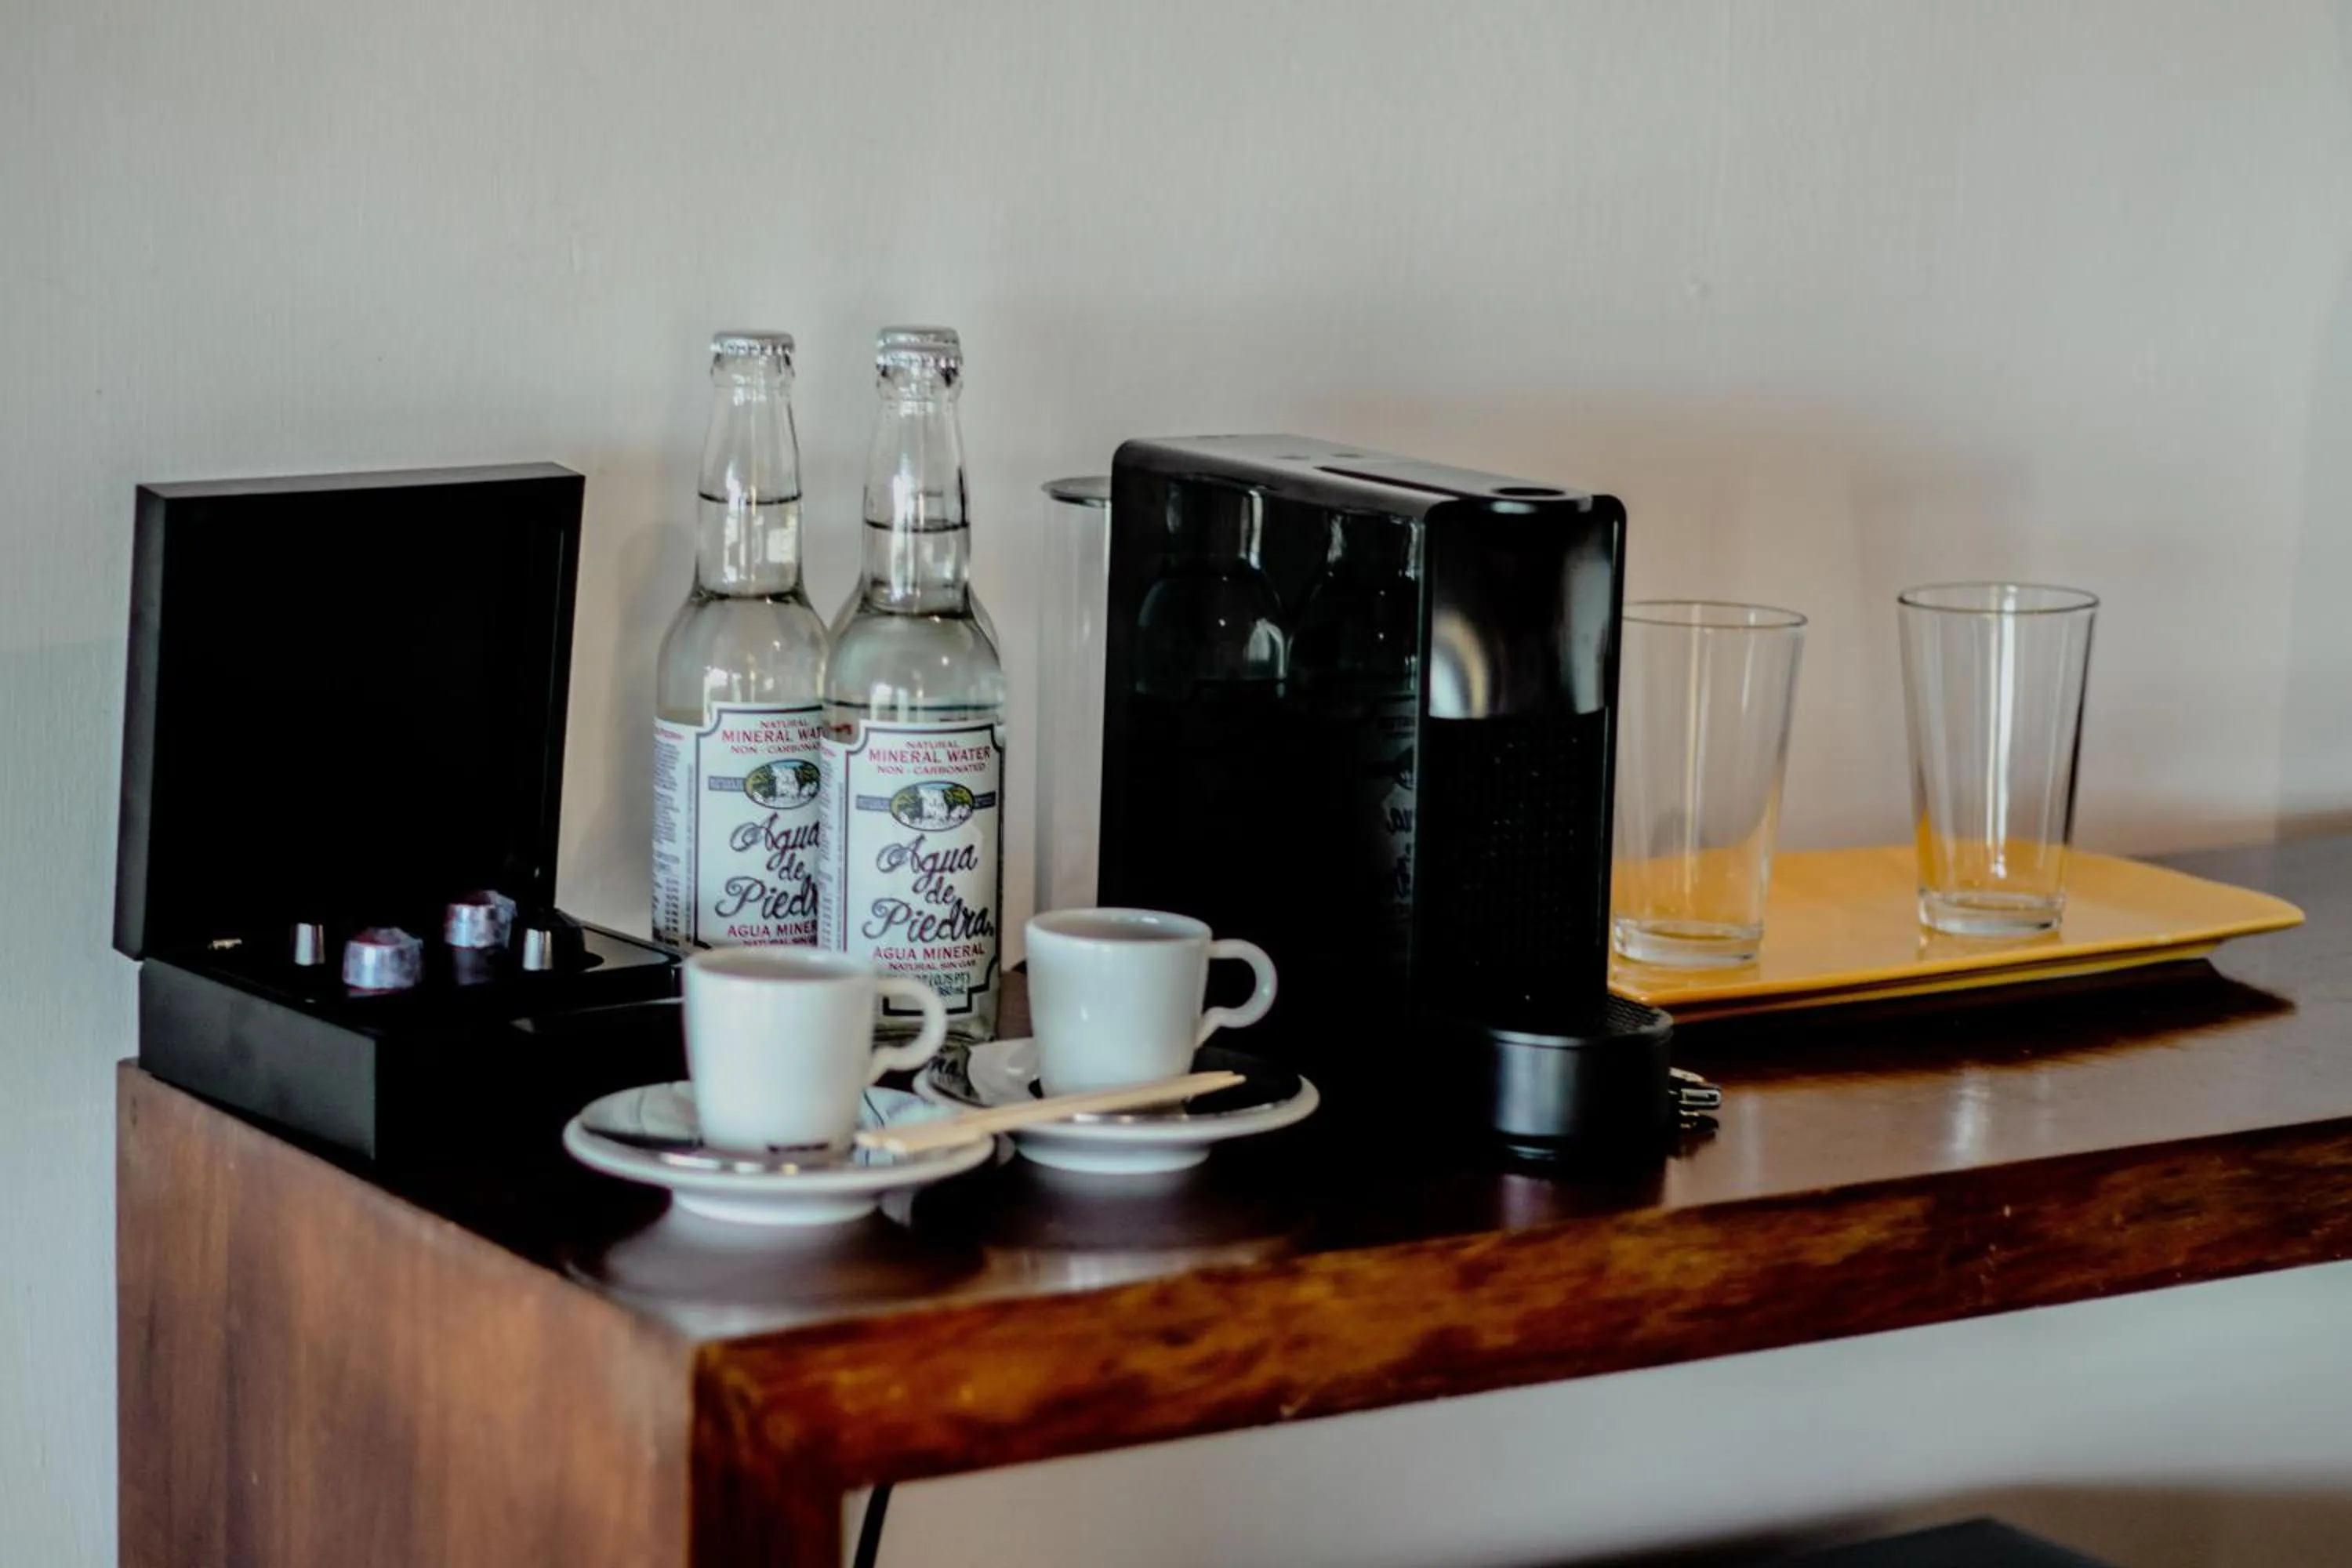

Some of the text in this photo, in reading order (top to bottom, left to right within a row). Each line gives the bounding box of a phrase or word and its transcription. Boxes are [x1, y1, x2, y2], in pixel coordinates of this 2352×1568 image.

[759, 718, 808, 728] NATURAL
[721, 728, 792, 743] MINERAL
[731, 745, 757, 754] NON
[905, 740, 959, 749] NATURAL
[868, 745, 991, 764] MINERAL WATER
[877, 764, 904, 775] NON
[913, 762, 986, 775] CARBONATED
[779, 852, 806, 881] de
[876, 833, 978, 894] Agua
[924, 875, 957, 905] de
[862, 896, 994, 943] Piedra
[727, 924, 771, 938] AGUA
[873, 942, 985, 960] AGUA MINERAL
[887, 962, 935, 971] NATURAL
